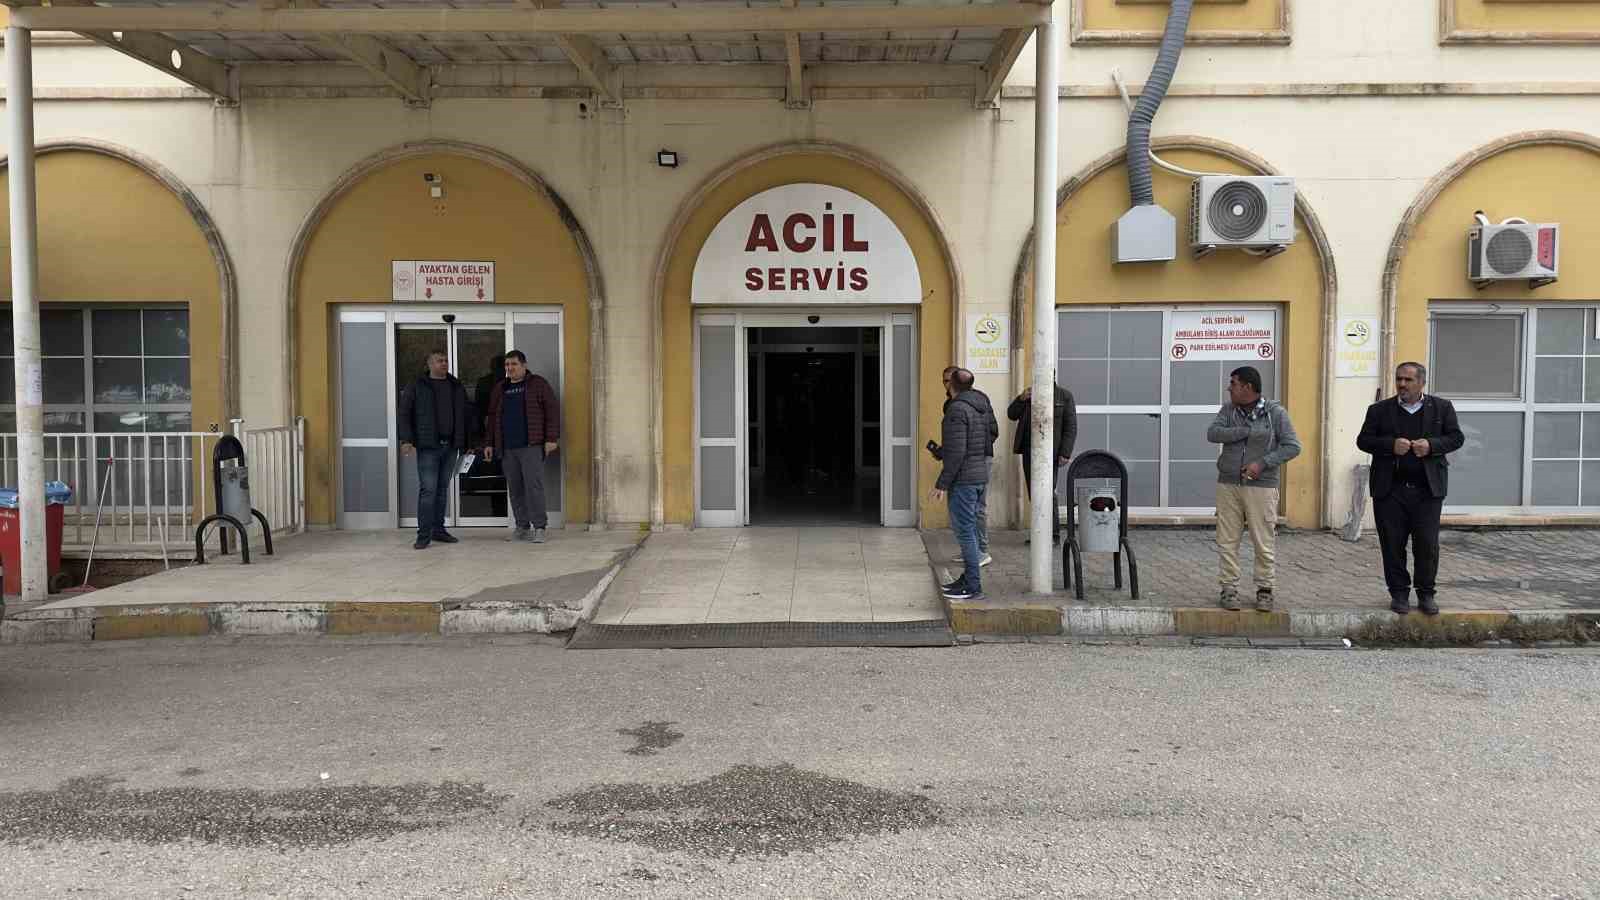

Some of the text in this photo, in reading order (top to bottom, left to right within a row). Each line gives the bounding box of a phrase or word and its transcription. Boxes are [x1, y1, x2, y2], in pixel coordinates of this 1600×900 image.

[745, 202, 869, 252] ACİL
[419, 264, 490, 274] AYAKTAN GELEN
[426, 276, 455, 286] HASTA
[745, 261, 869, 291] SERVİS
[1230, 343, 1256, 351] YASAKTIR
